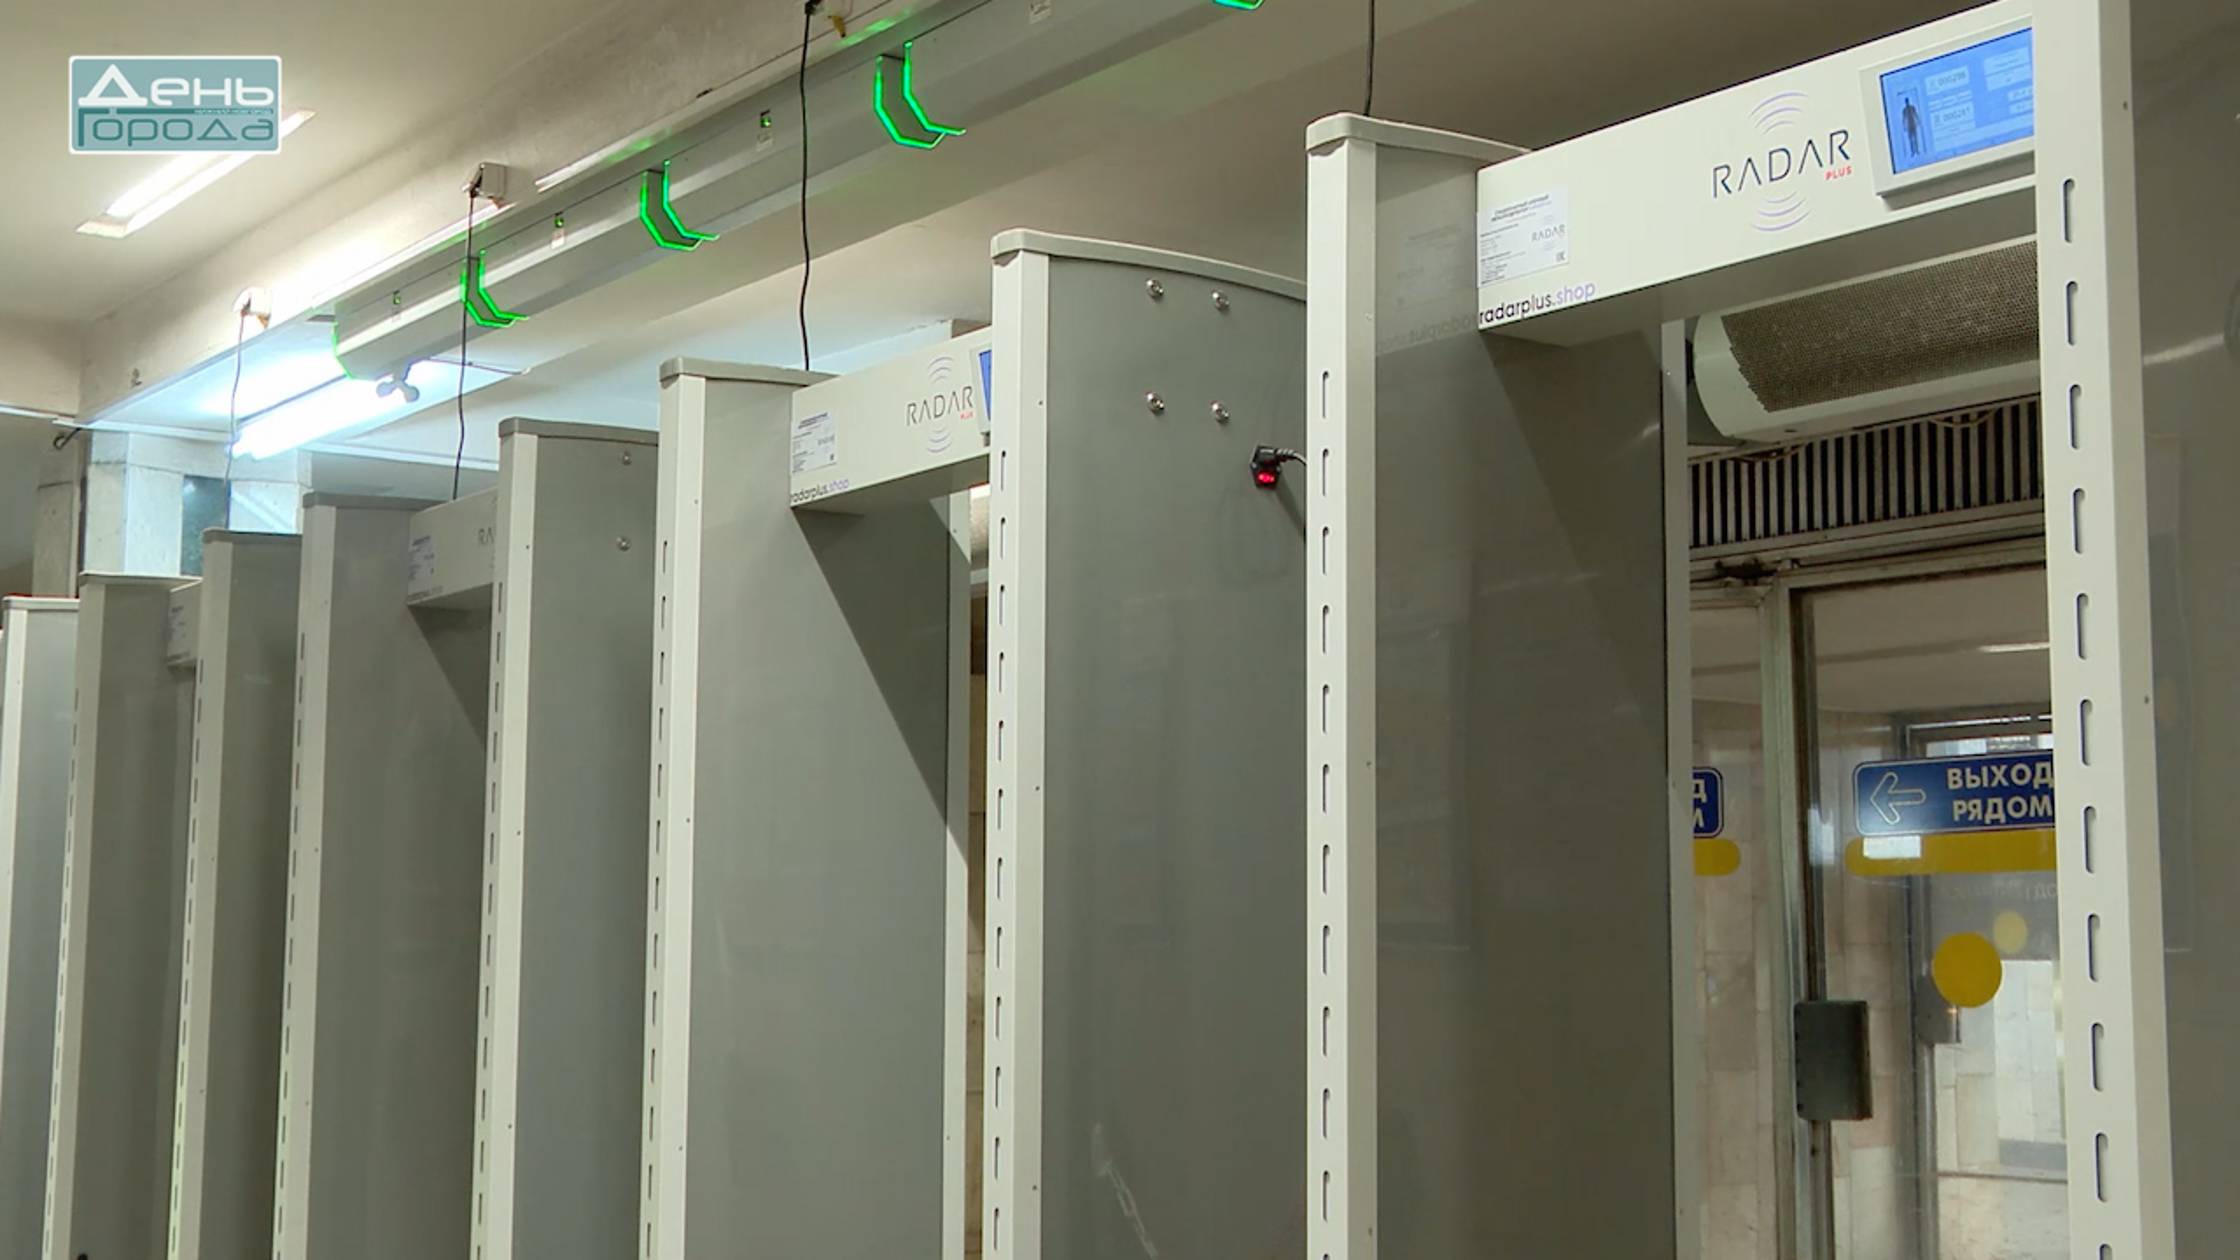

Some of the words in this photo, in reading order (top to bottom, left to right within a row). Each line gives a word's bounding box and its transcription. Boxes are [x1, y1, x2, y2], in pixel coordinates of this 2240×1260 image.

[1712, 128, 1851, 199] RADAR
[1823, 165, 1853, 182] PLUS
[1530, 224, 1567, 243] RADAR
[1479, 282, 1597, 325] radarplus.shop
[906, 385, 974, 426] RADAR
[1946, 761, 2055, 791] ВЫХОД
[1952, 794, 2053, 825] РЯДОМ
